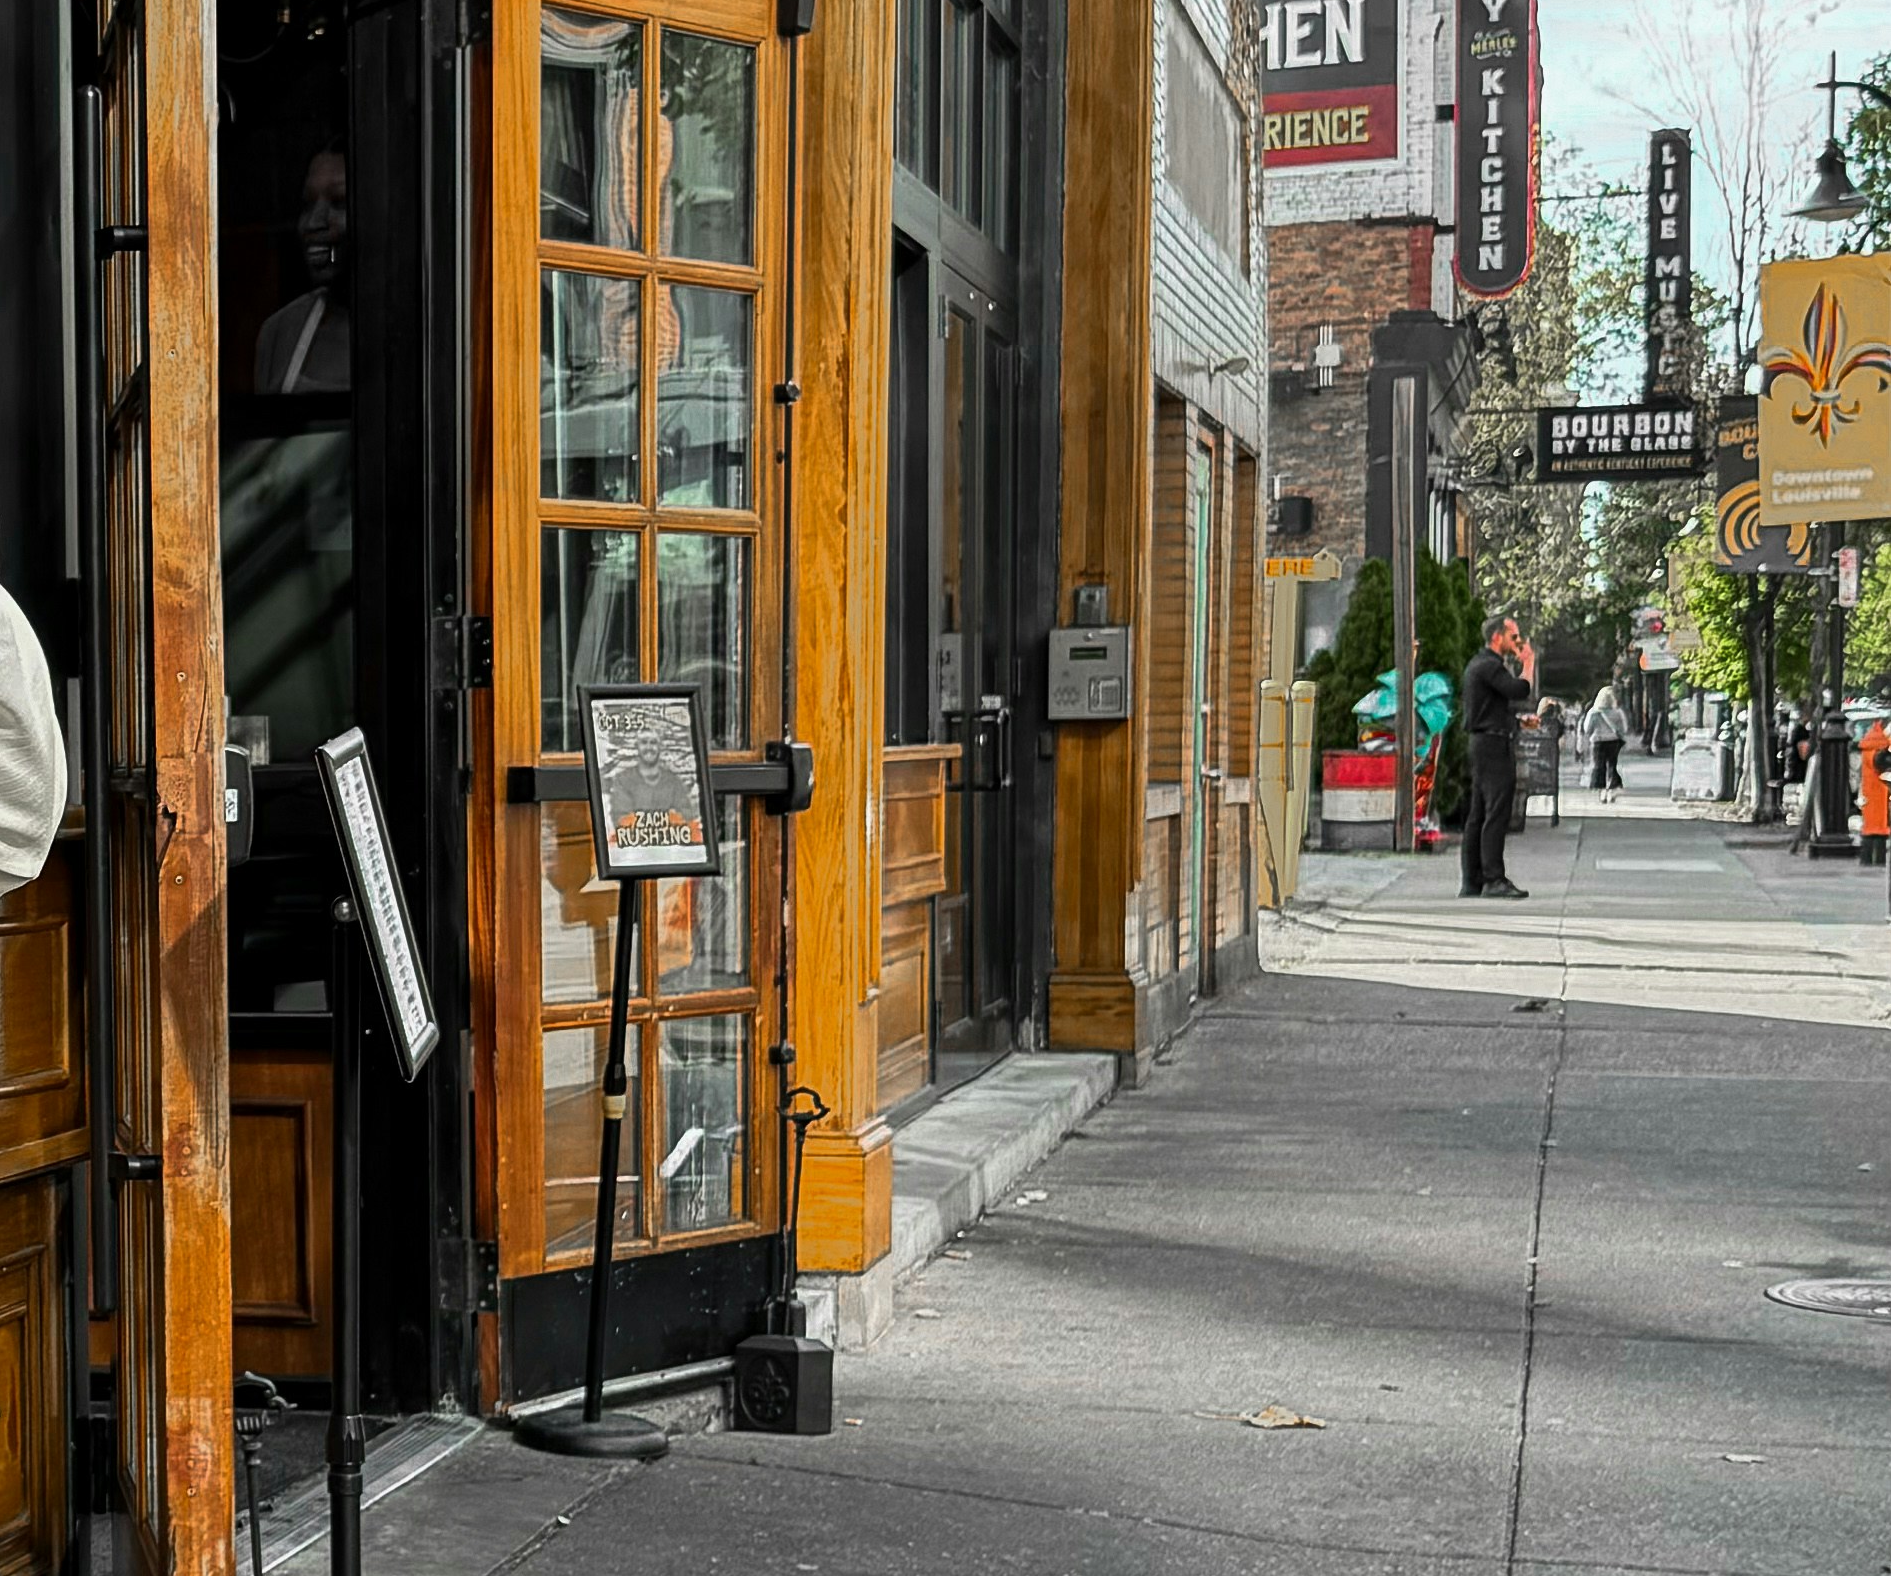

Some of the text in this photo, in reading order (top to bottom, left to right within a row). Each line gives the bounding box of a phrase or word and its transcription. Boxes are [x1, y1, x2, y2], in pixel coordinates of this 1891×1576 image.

[1263, 105, 1371, 150] RIENCE
[1478, 68, 1505, 271] KITCHEN
[1658, 141, 1680, 240] LIVE
[1551, 411, 1694, 438] BOURBON
[1552, 435, 1693, 454] BY THE GLASS
[1772, 468, 1874, 486] Downtown
[1772, 486, 1861, 505] Louisville
[635, 811, 669, 828] ZACH
[617, 826, 692, 846] RUSHING
